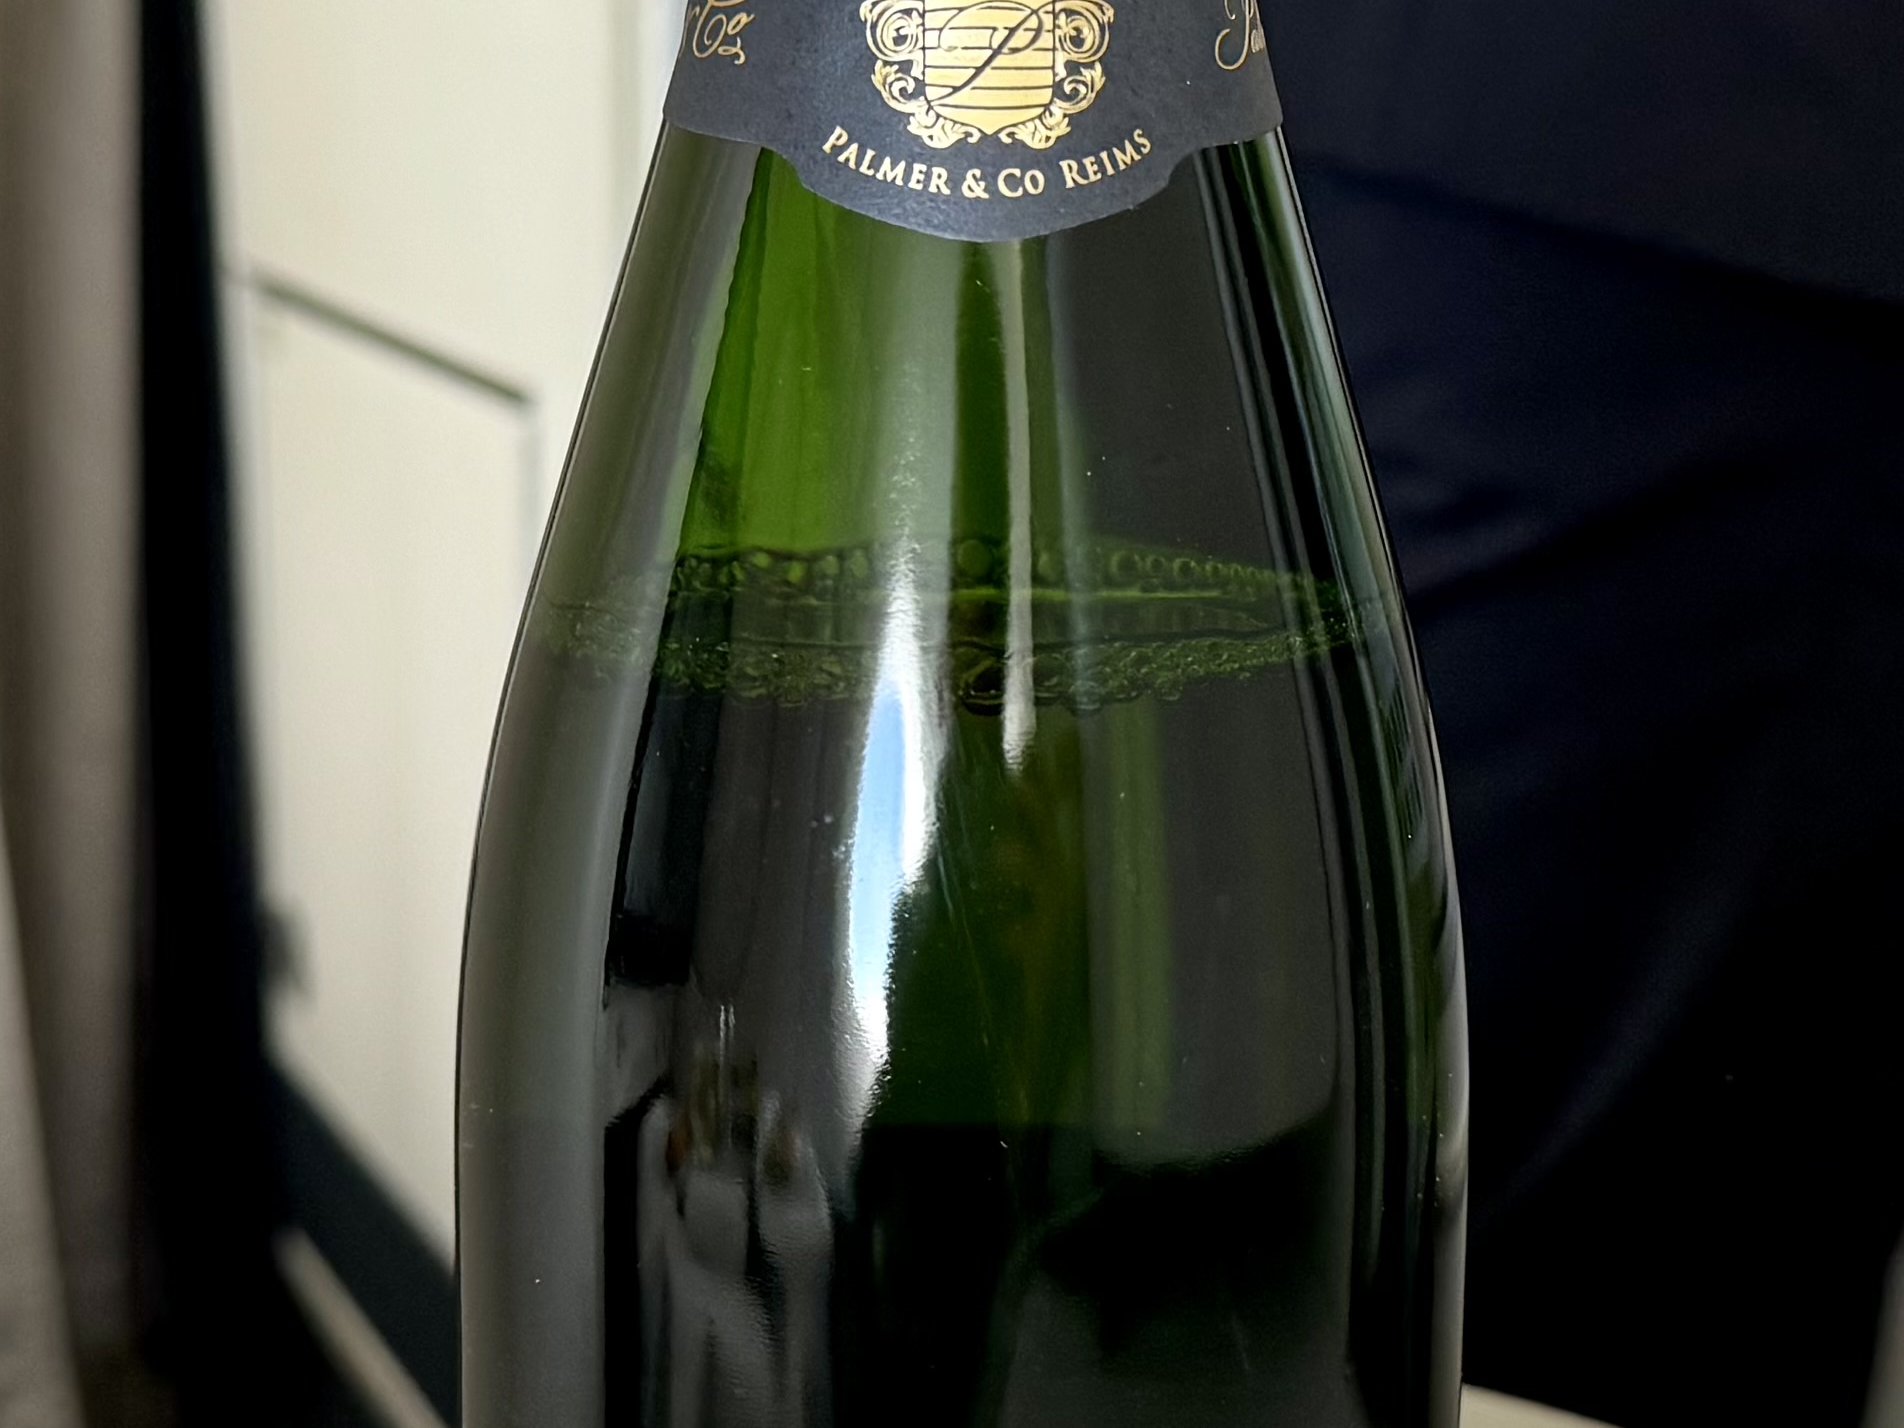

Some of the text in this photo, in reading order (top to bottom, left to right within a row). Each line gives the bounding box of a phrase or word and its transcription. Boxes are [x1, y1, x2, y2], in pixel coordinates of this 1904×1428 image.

[822, 125, 1153, 199] PALMER & Co REIMS
